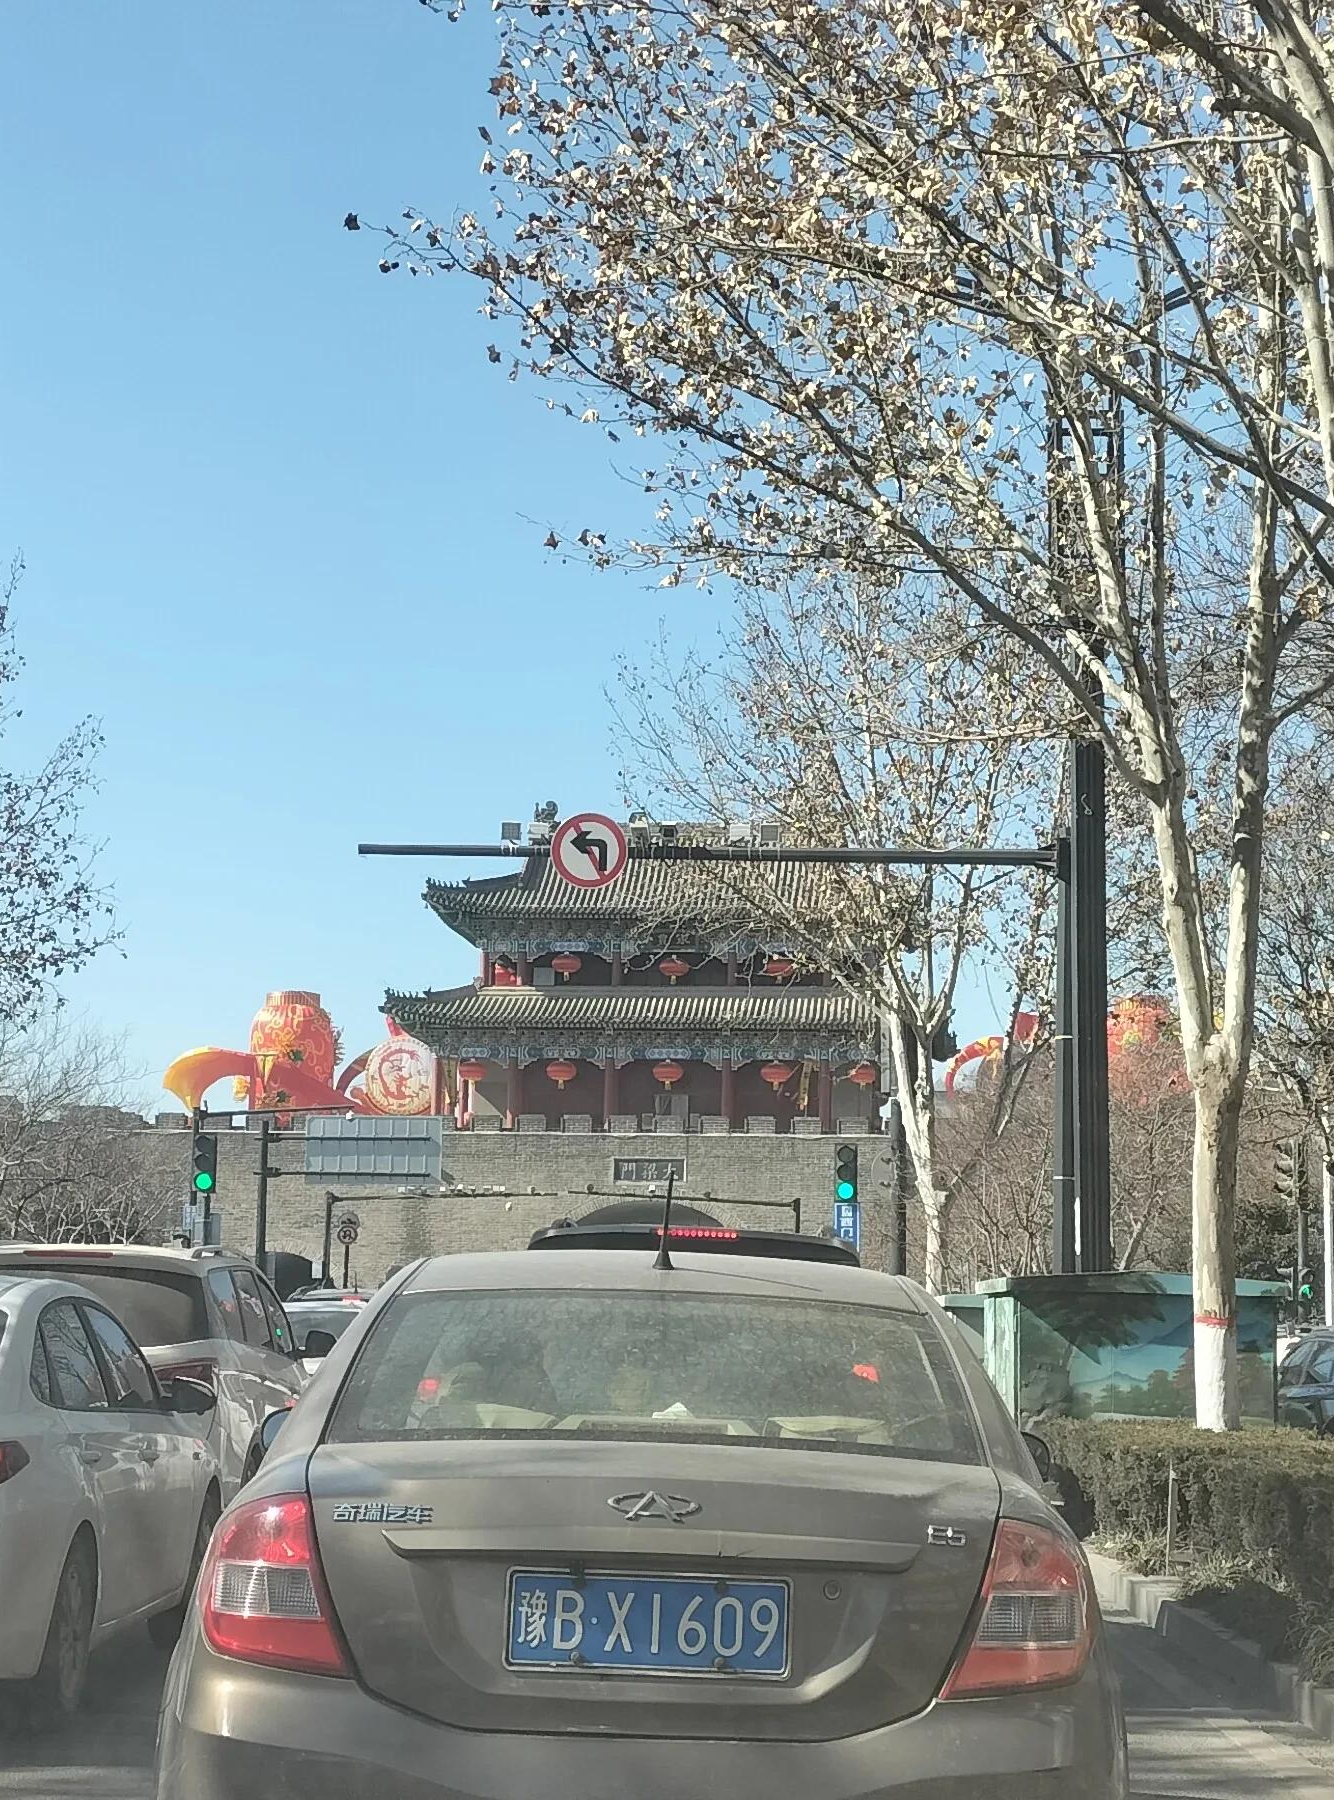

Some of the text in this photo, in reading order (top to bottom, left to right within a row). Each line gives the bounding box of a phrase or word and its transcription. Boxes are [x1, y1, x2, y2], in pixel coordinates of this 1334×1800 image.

[332, 1502, 434, 1524] 奇瑞汽车
[927, 1524, 966, 1546] E5
[516, 1588, 780, 1658] 豫B·X1609
